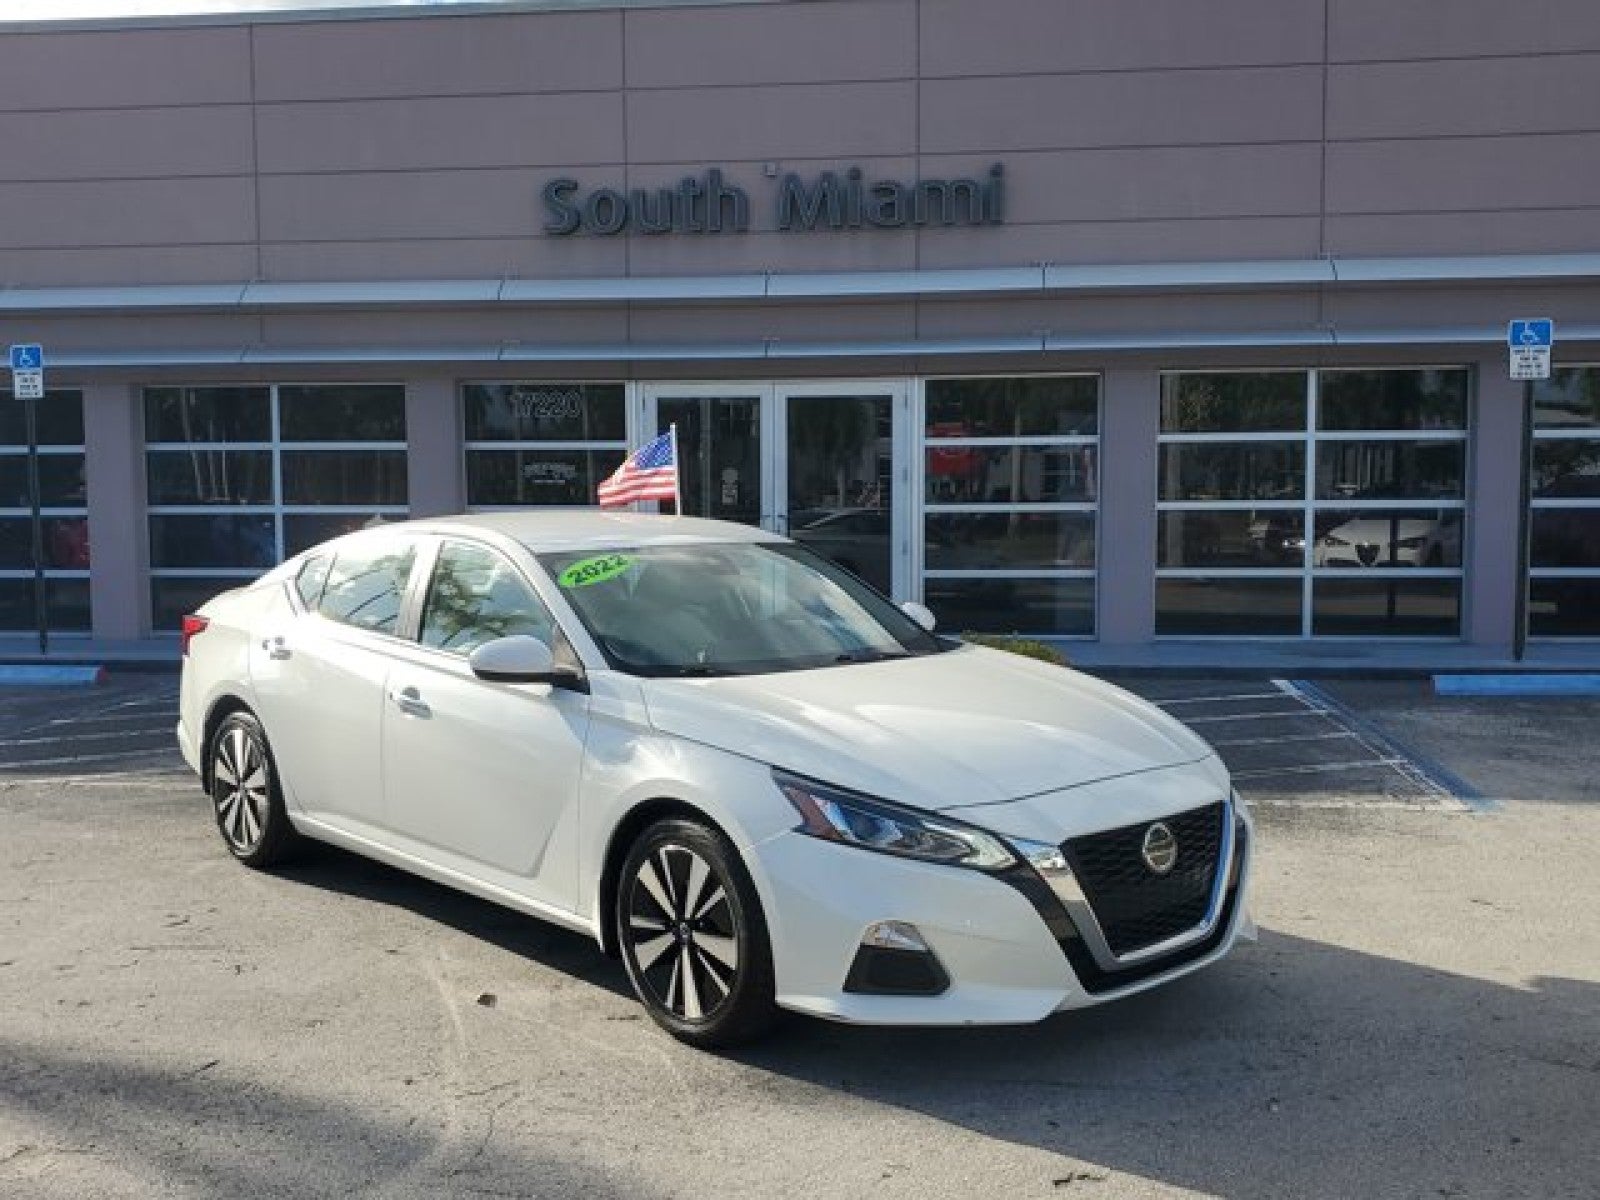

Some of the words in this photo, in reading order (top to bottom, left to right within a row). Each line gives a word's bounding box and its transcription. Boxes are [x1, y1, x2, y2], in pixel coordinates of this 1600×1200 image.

[541, 167, 750, 235] South
[778, 162, 1005, 231] Miami
[566, 554, 628, 583] 2022
